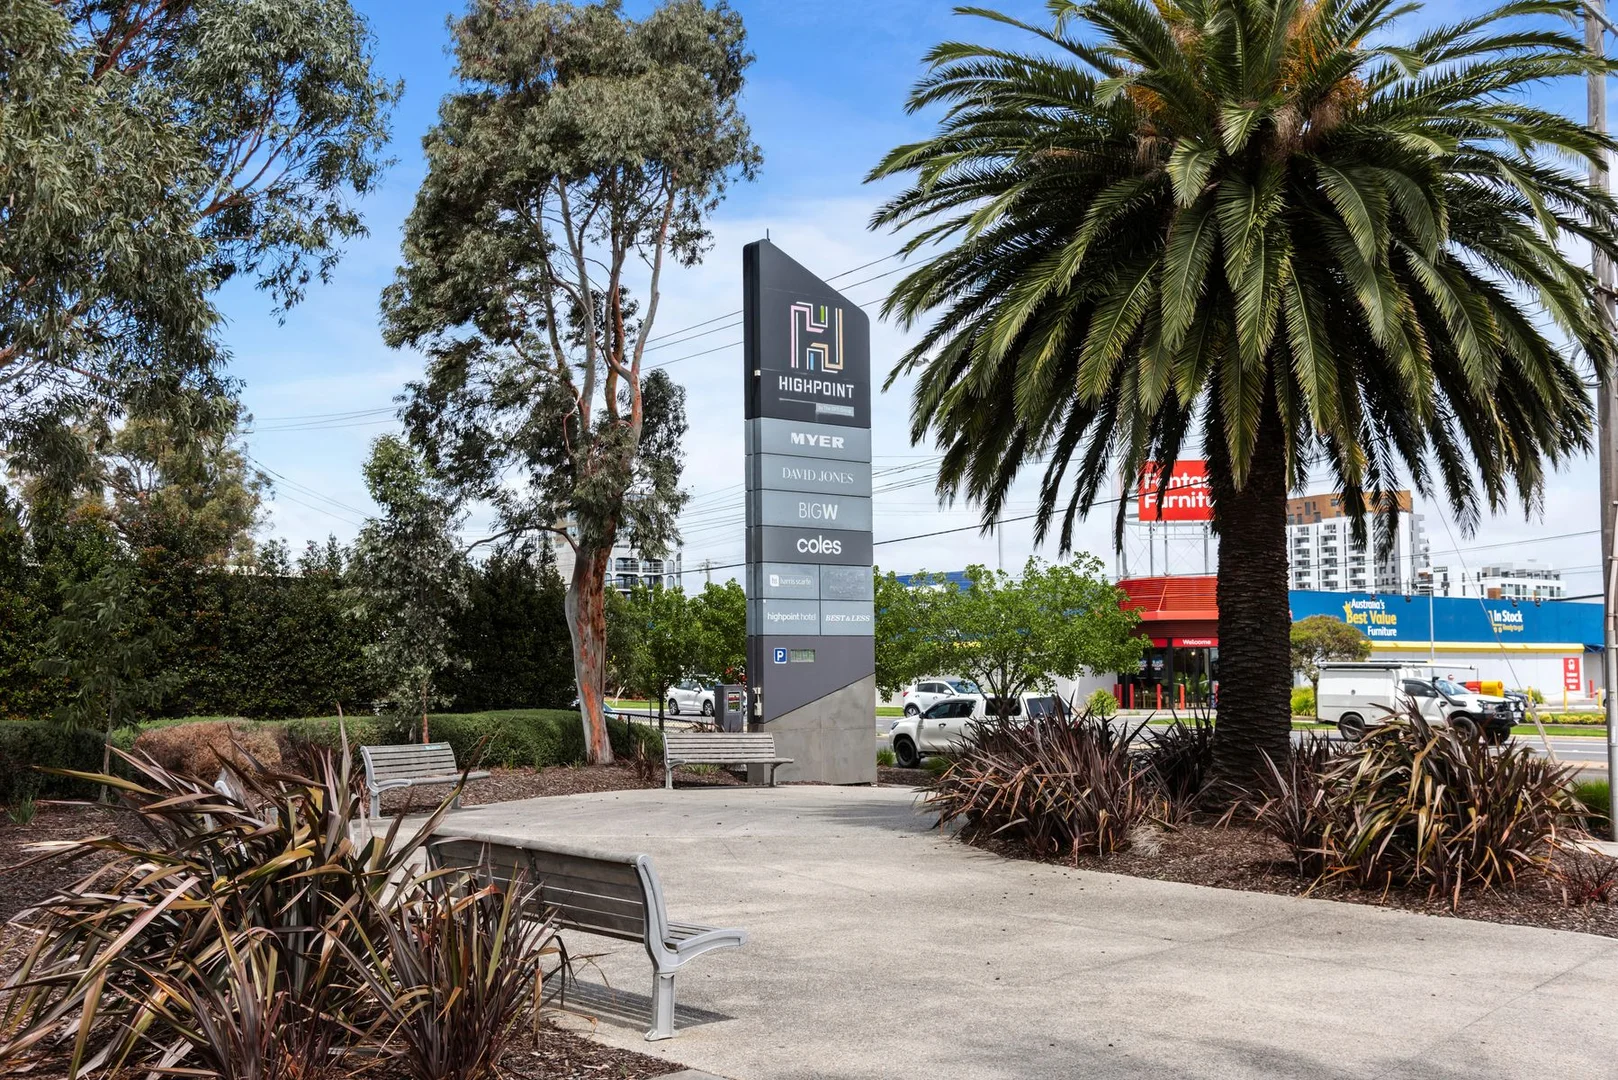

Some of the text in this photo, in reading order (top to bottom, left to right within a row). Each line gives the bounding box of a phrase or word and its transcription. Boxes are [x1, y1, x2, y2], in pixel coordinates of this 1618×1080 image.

[778, 375, 855, 398] HIGHPOINT
[790, 432, 845, 448] MYER
[782, 467, 854, 484] DAVID JONES
[797, 535, 842, 554] coles
[1351, 598, 1385, 610] Australia's
[767, 612, 800, 623] highpoint
[1346, 608, 1397, 625] Best Value
[1494, 610, 1523, 622] In Stock
[1367, 626, 1397, 636] Furniture
[776, 650, 784, 661] P
